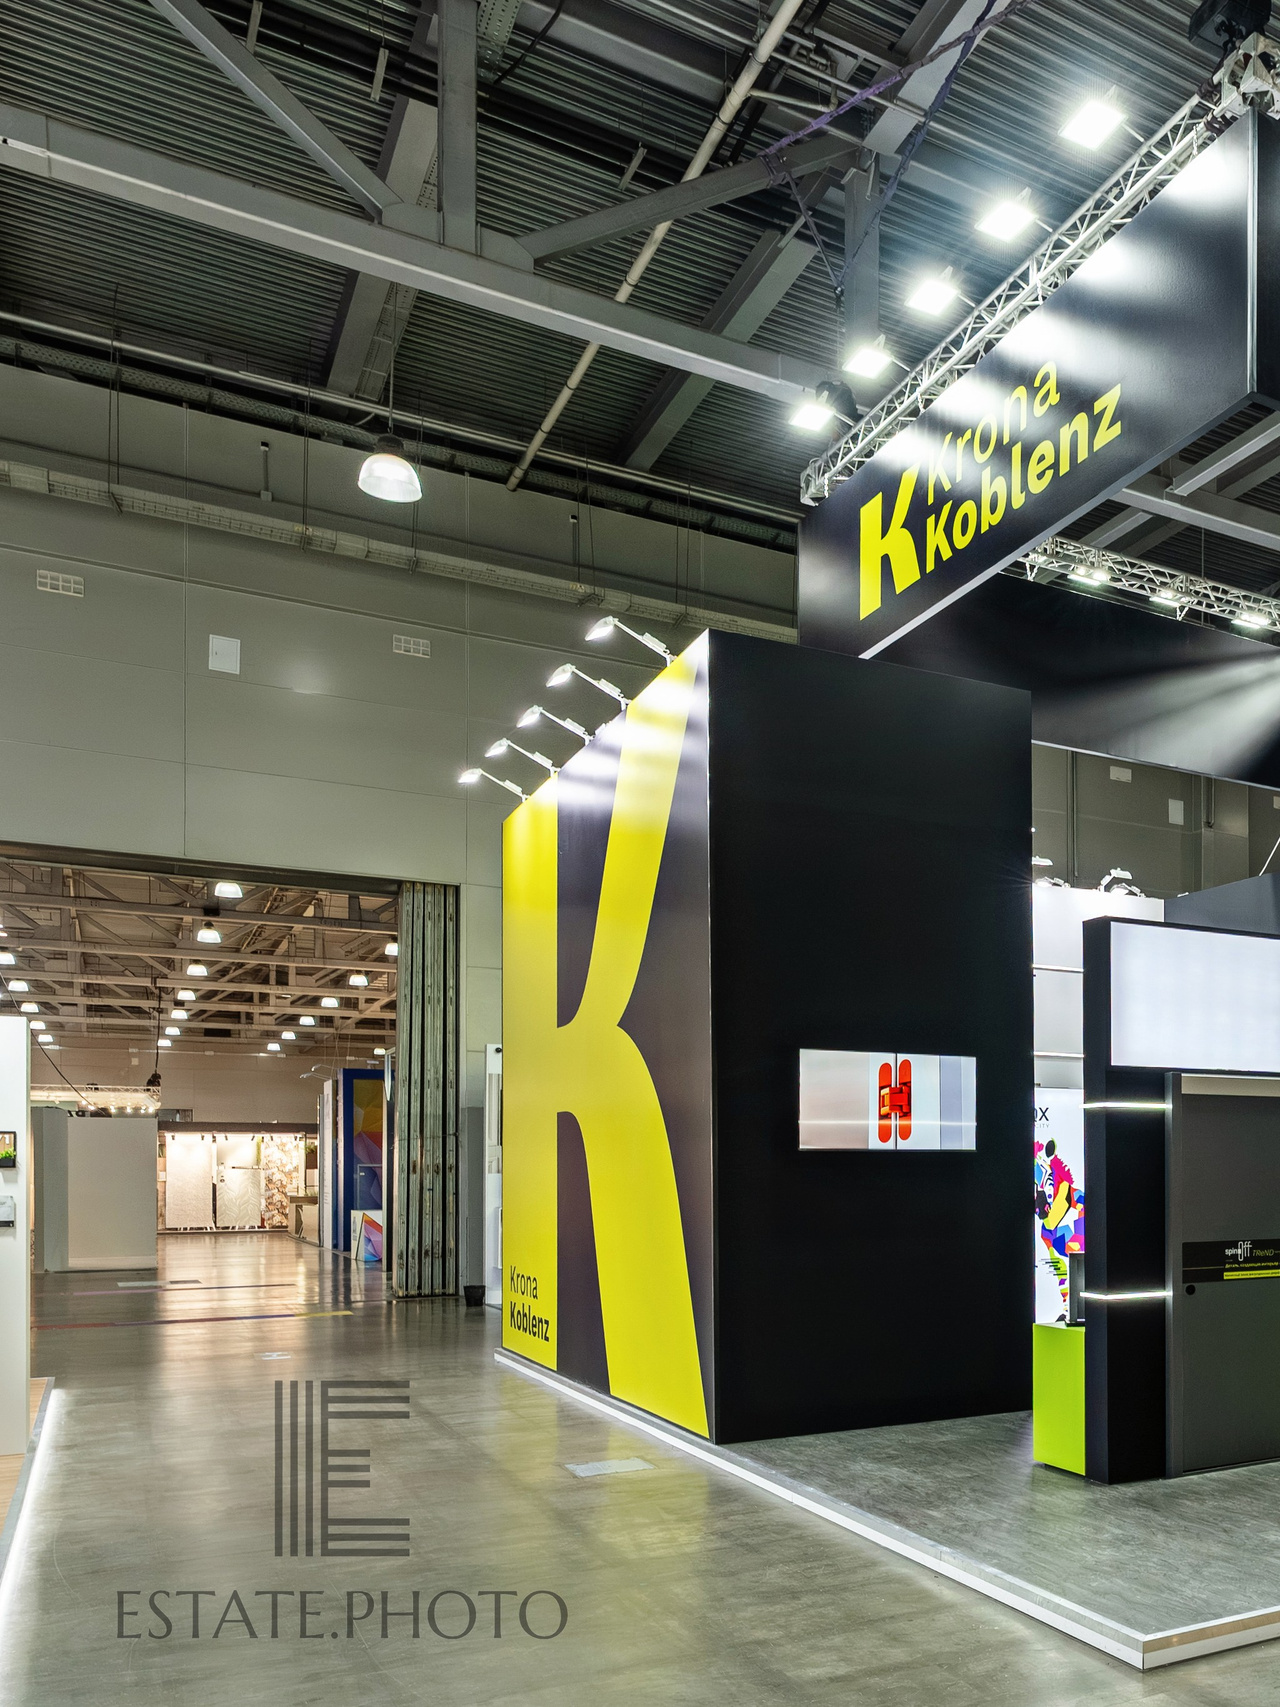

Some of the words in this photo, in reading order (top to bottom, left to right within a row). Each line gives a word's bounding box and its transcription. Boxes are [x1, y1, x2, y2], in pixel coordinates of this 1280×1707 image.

[926, 383, 1122, 573] Koblenz
[927, 361, 1061, 506] Krona
[860, 460, 921, 621] K
[510, 1265, 538, 1300] Krona
[510, 1301, 550, 1343] Koblenz
